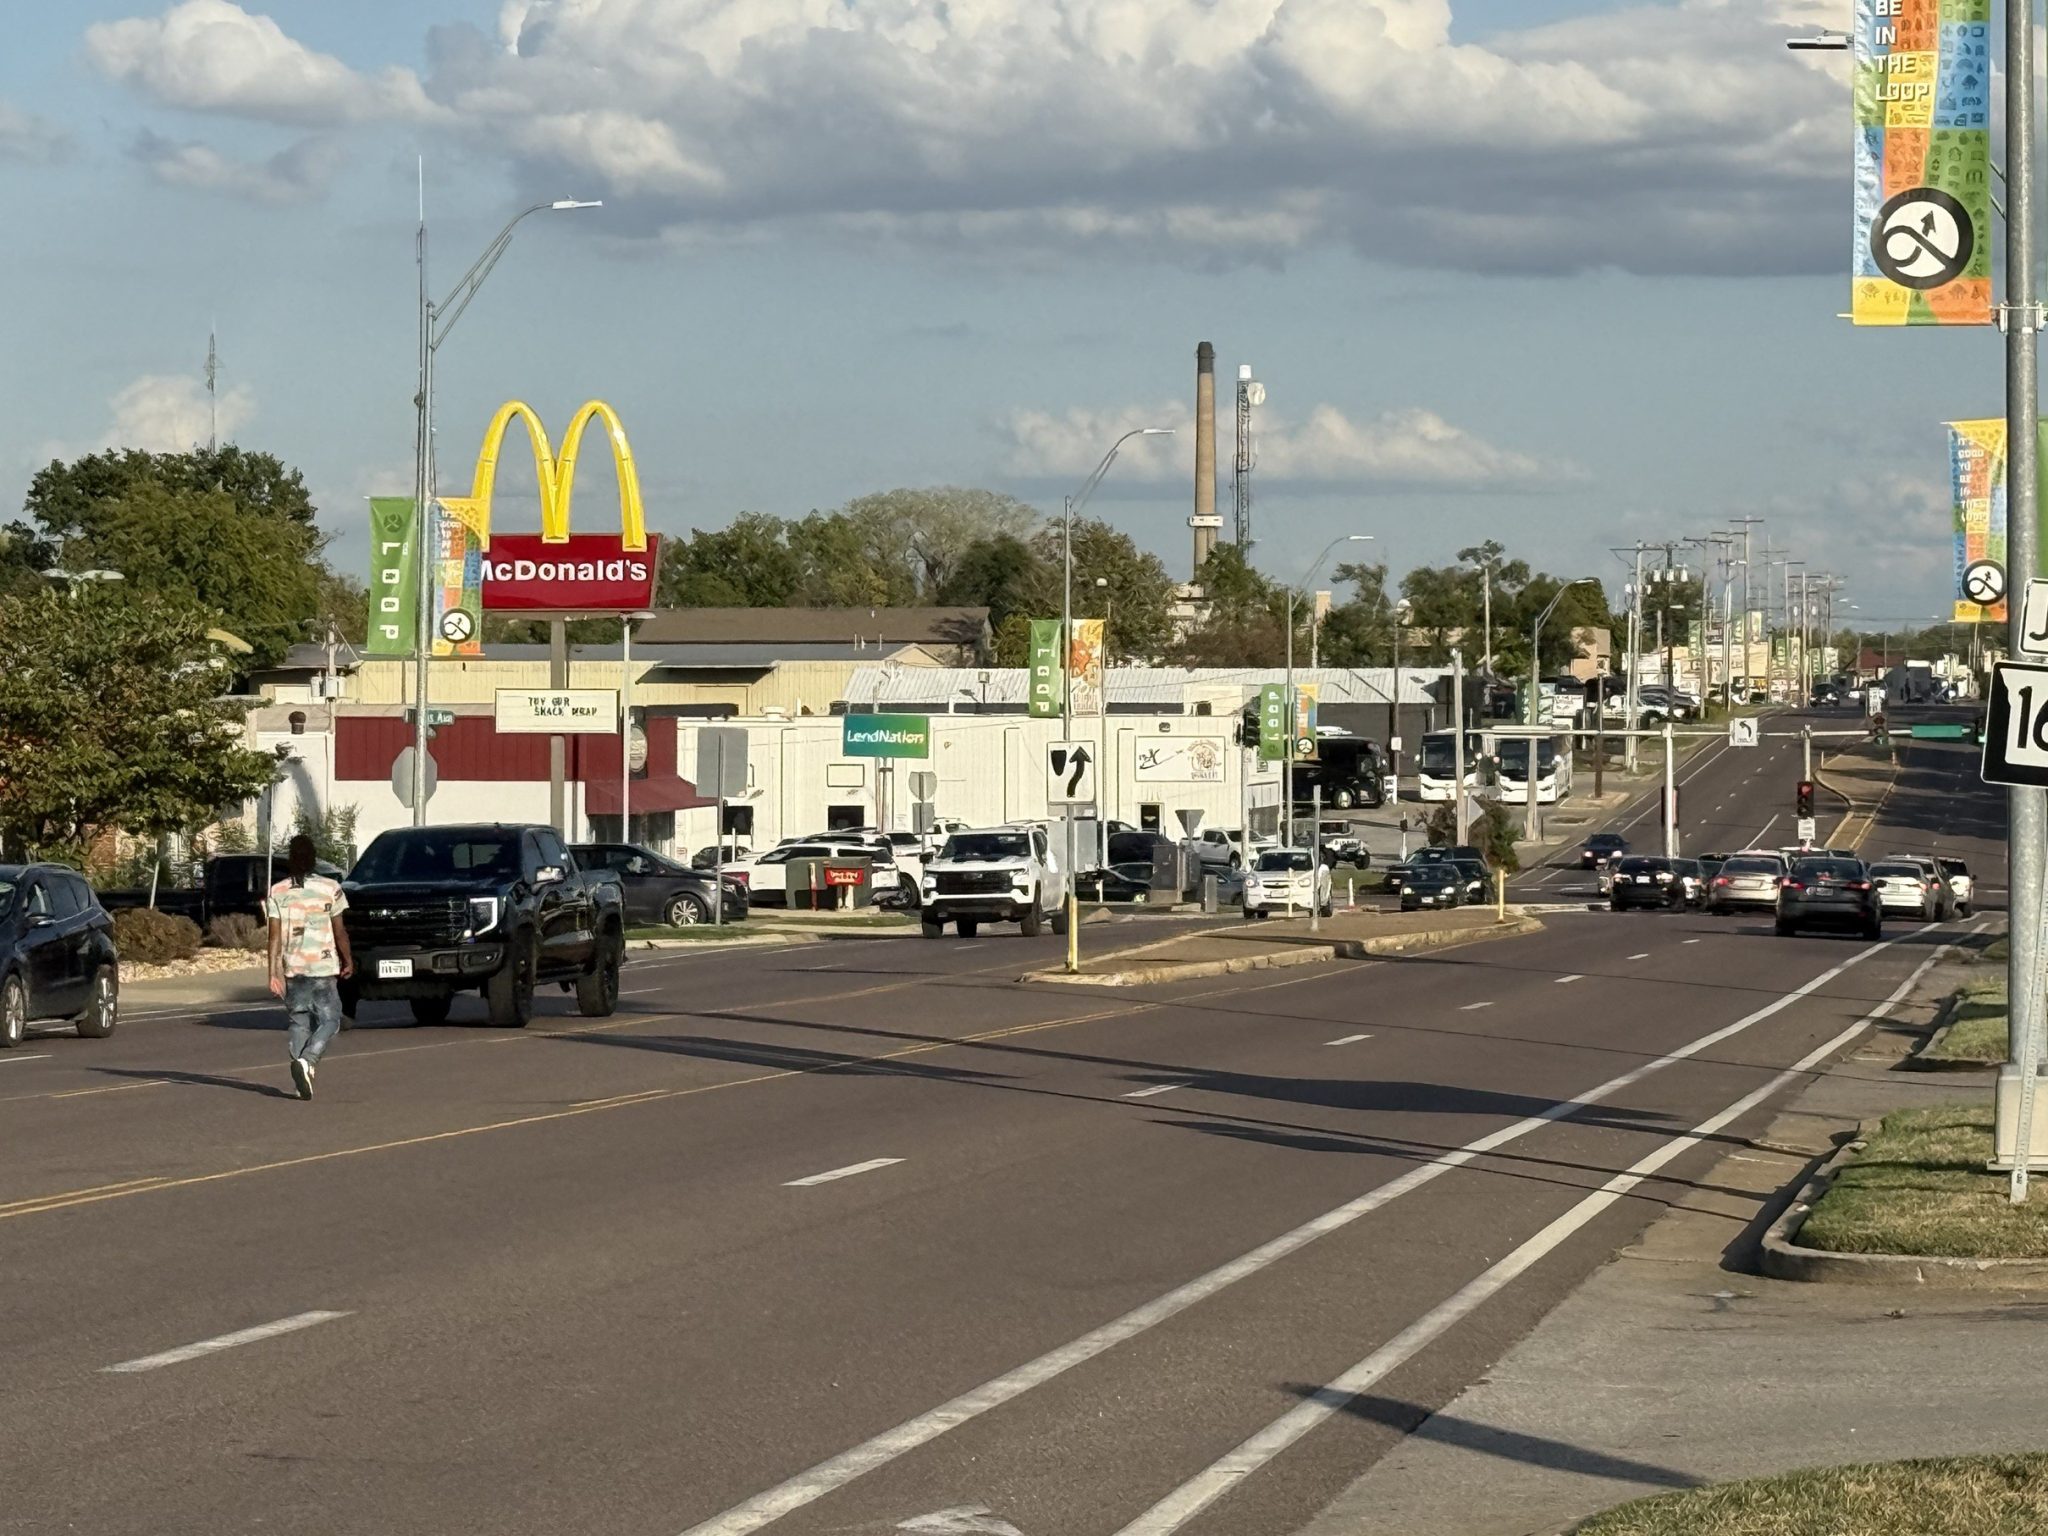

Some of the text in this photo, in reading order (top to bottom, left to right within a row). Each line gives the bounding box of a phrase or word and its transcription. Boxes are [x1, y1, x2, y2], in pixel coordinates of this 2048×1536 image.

[1875, 0, 1903, 16] BE
[1875, 26, 1897, 45] IN
[1873, 54, 1917, 74] THE
[1875, 82, 1930, 102] LOOP
[379, 542, 401, 640] LOOP
[847, 729, 925, 744] LendNation
